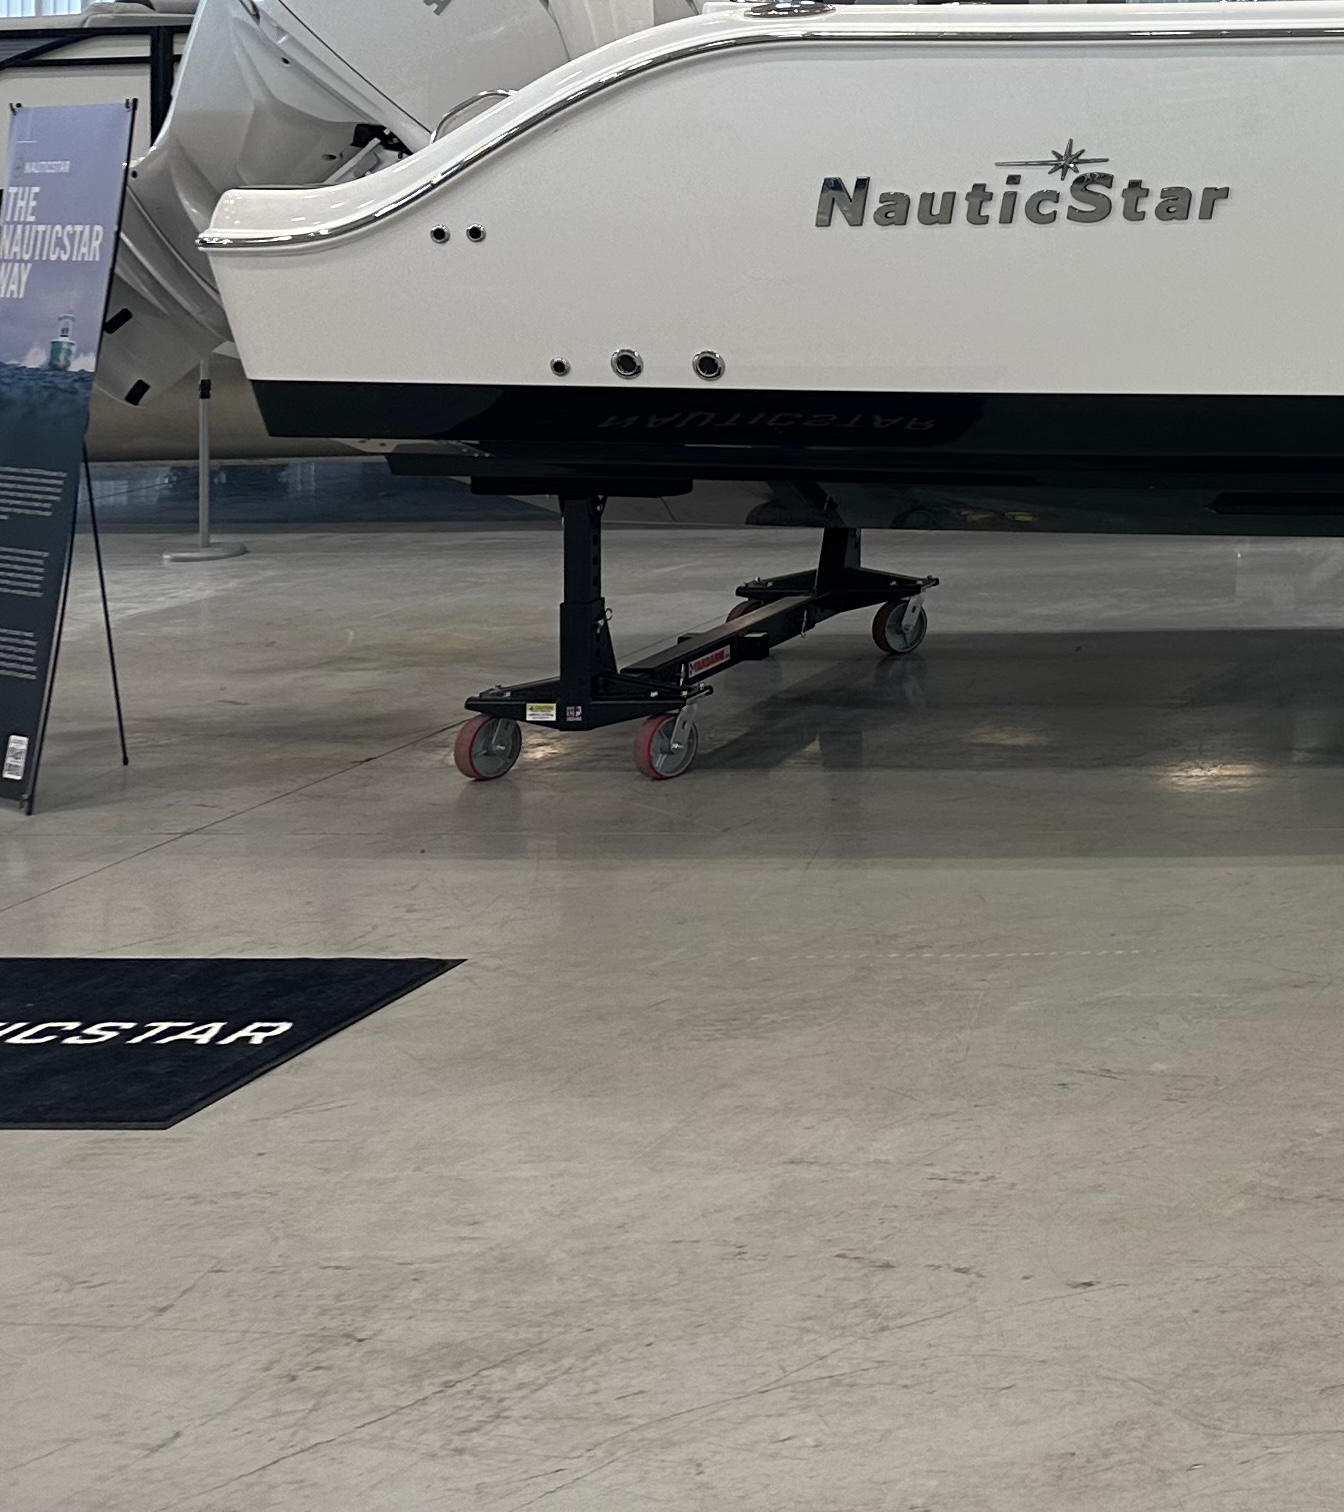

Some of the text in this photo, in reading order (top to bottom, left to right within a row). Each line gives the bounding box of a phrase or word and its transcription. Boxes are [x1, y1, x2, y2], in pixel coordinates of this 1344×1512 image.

[5, 186, 41, 222] THE
[814, 172, 1231, 227] NauticStar
[0, 224, 104, 261] NAUTICSTAR
[0, 1021, 294, 1045] ICSTAR
